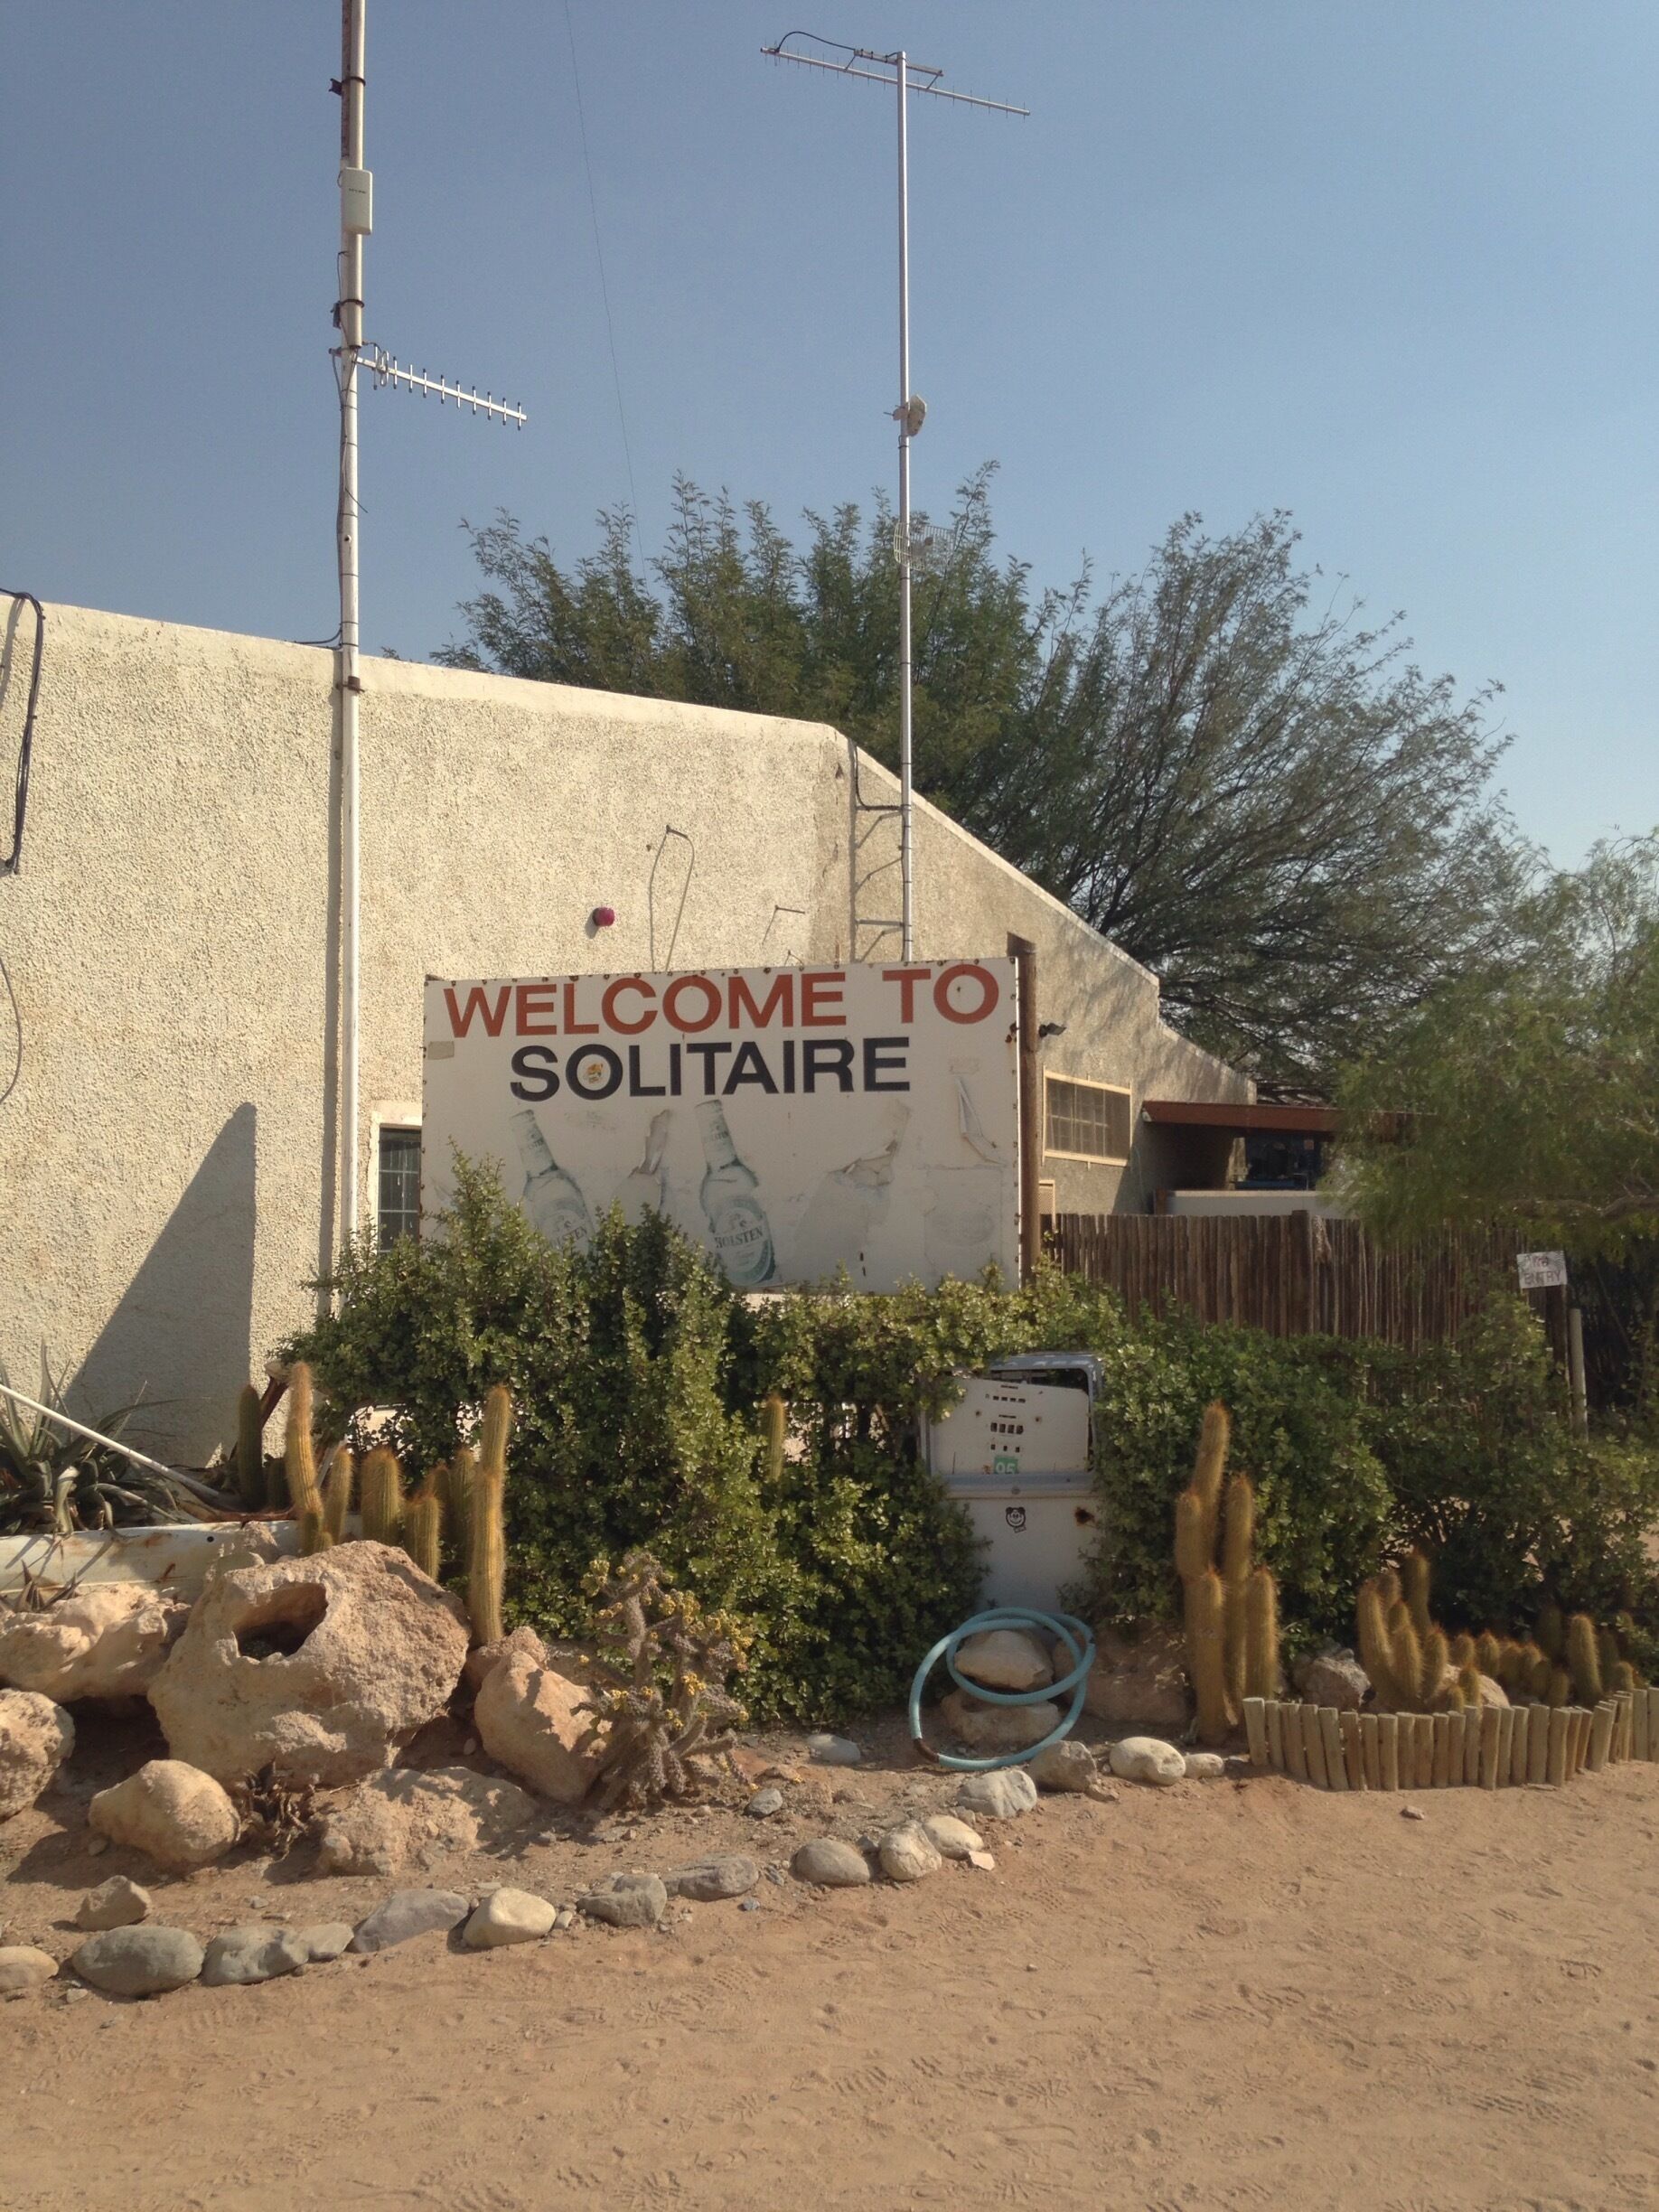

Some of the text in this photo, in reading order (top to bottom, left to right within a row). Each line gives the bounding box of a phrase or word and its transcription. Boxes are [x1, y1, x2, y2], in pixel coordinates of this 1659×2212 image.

[443, 963, 999, 1038] WELCOME TO
[510, 1036, 911, 1102] SOLITAIRE
[1523, 1270, 1561, 1286] ENTRY
